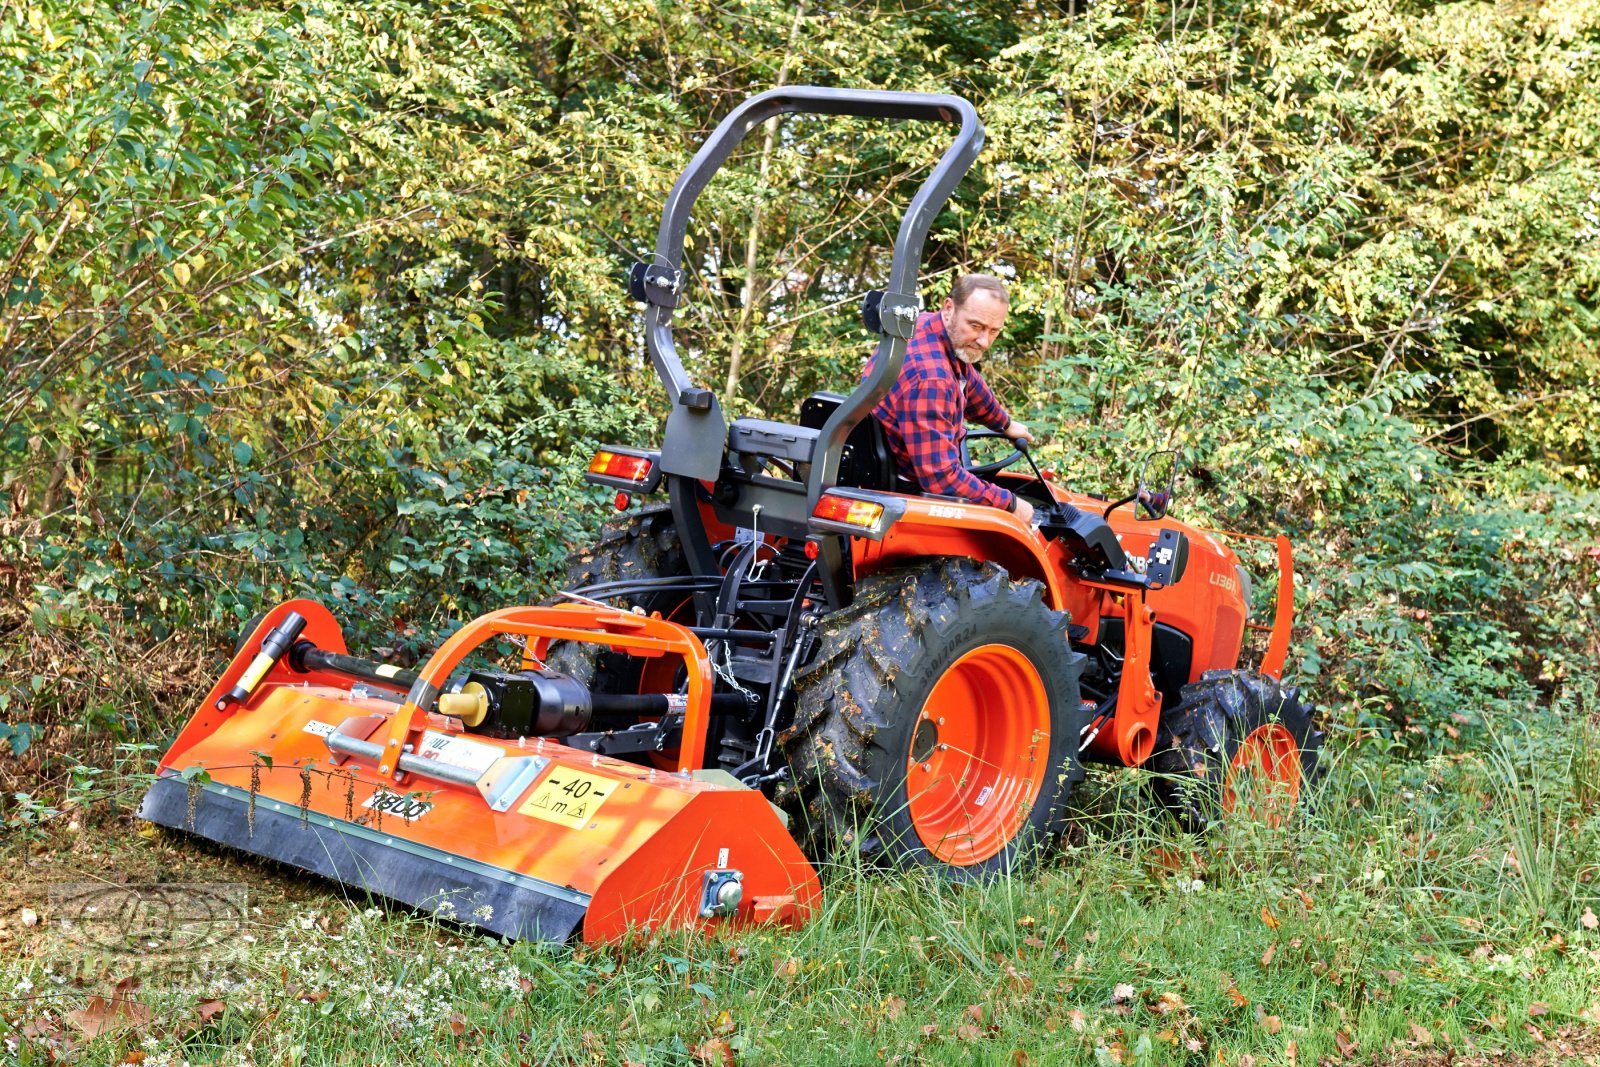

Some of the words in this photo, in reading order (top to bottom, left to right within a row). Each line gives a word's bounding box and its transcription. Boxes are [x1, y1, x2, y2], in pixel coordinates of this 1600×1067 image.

[928, 505, 966, 520] HST
[562, 778, 592, 798] 40
[551, 801, 568, 814] m
